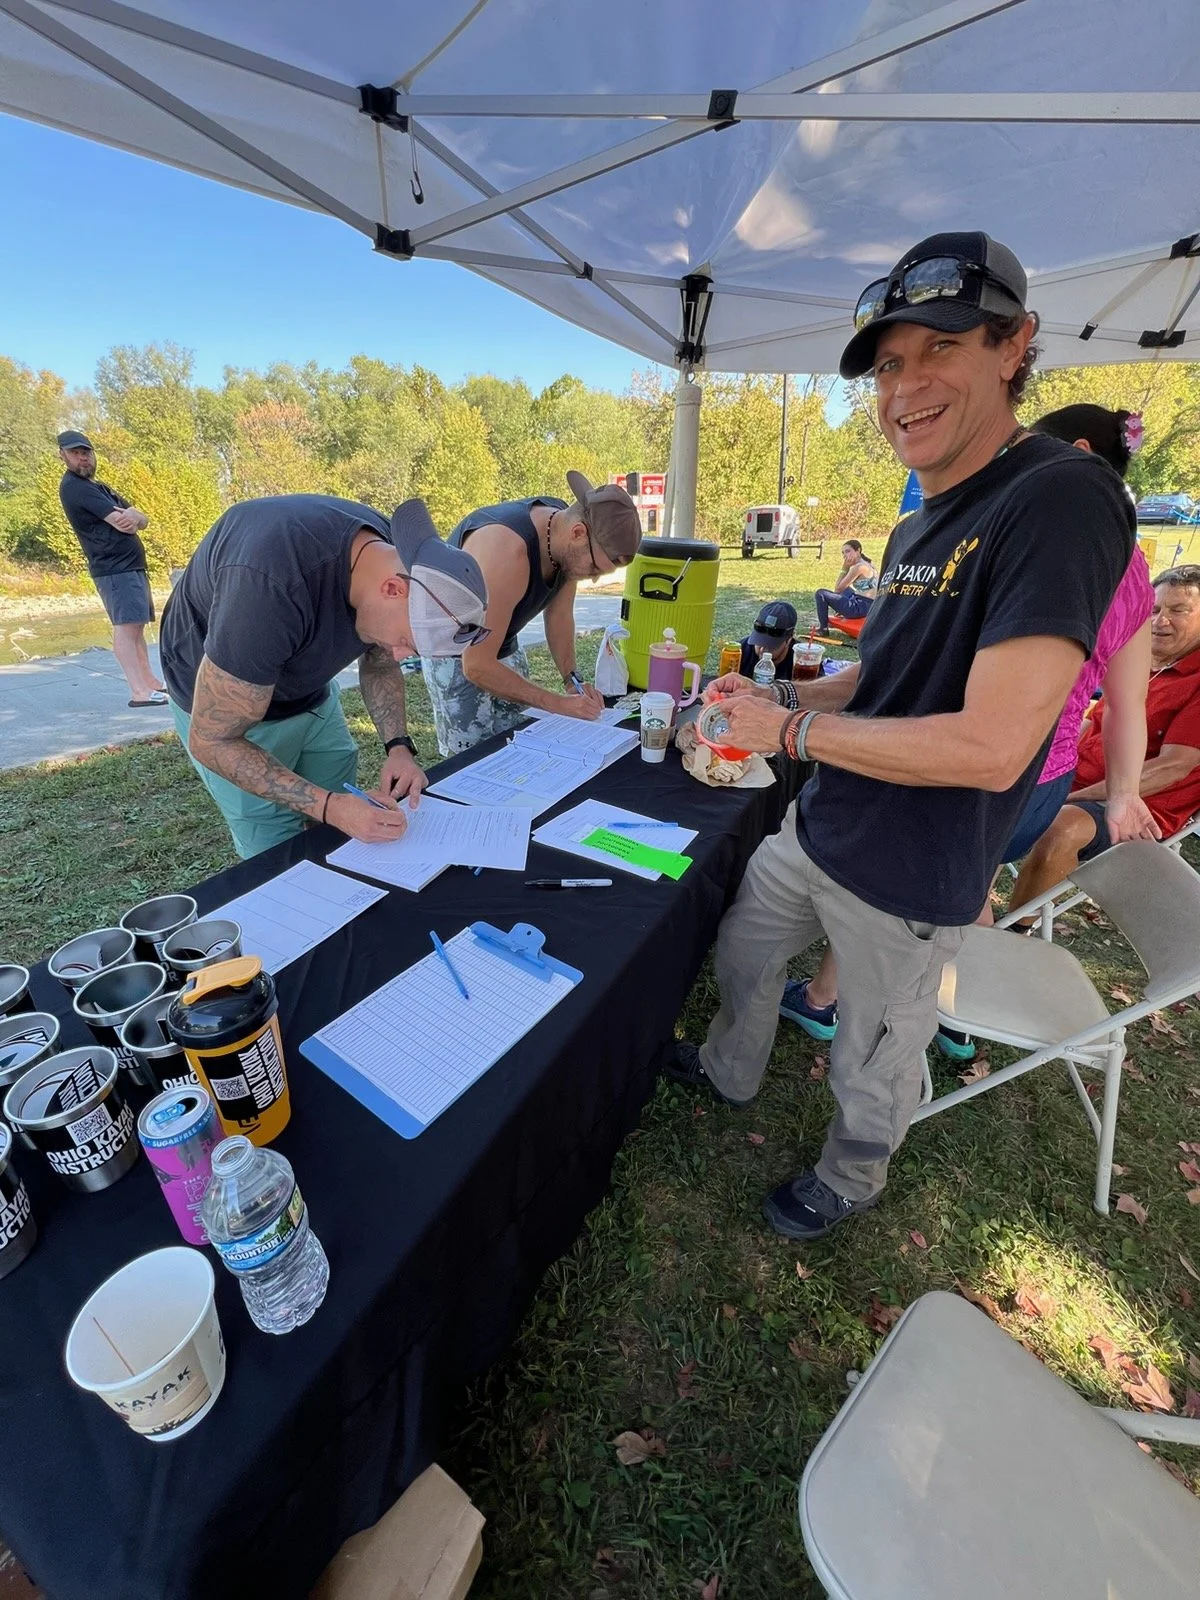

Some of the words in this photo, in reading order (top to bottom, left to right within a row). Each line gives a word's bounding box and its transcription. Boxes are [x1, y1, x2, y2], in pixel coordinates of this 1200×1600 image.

[238, 1044, 267, 1086] KAYAK
[251, 1079, 274, 1109] OHIO
[152, 1127, 197, 1147] SUGARFREE
[46, 1144, 92, 1164] OHIO
[227, 1236, 279, 1261] MOUNTAIN
[115, 1365, 190, 1408] KAYAK
